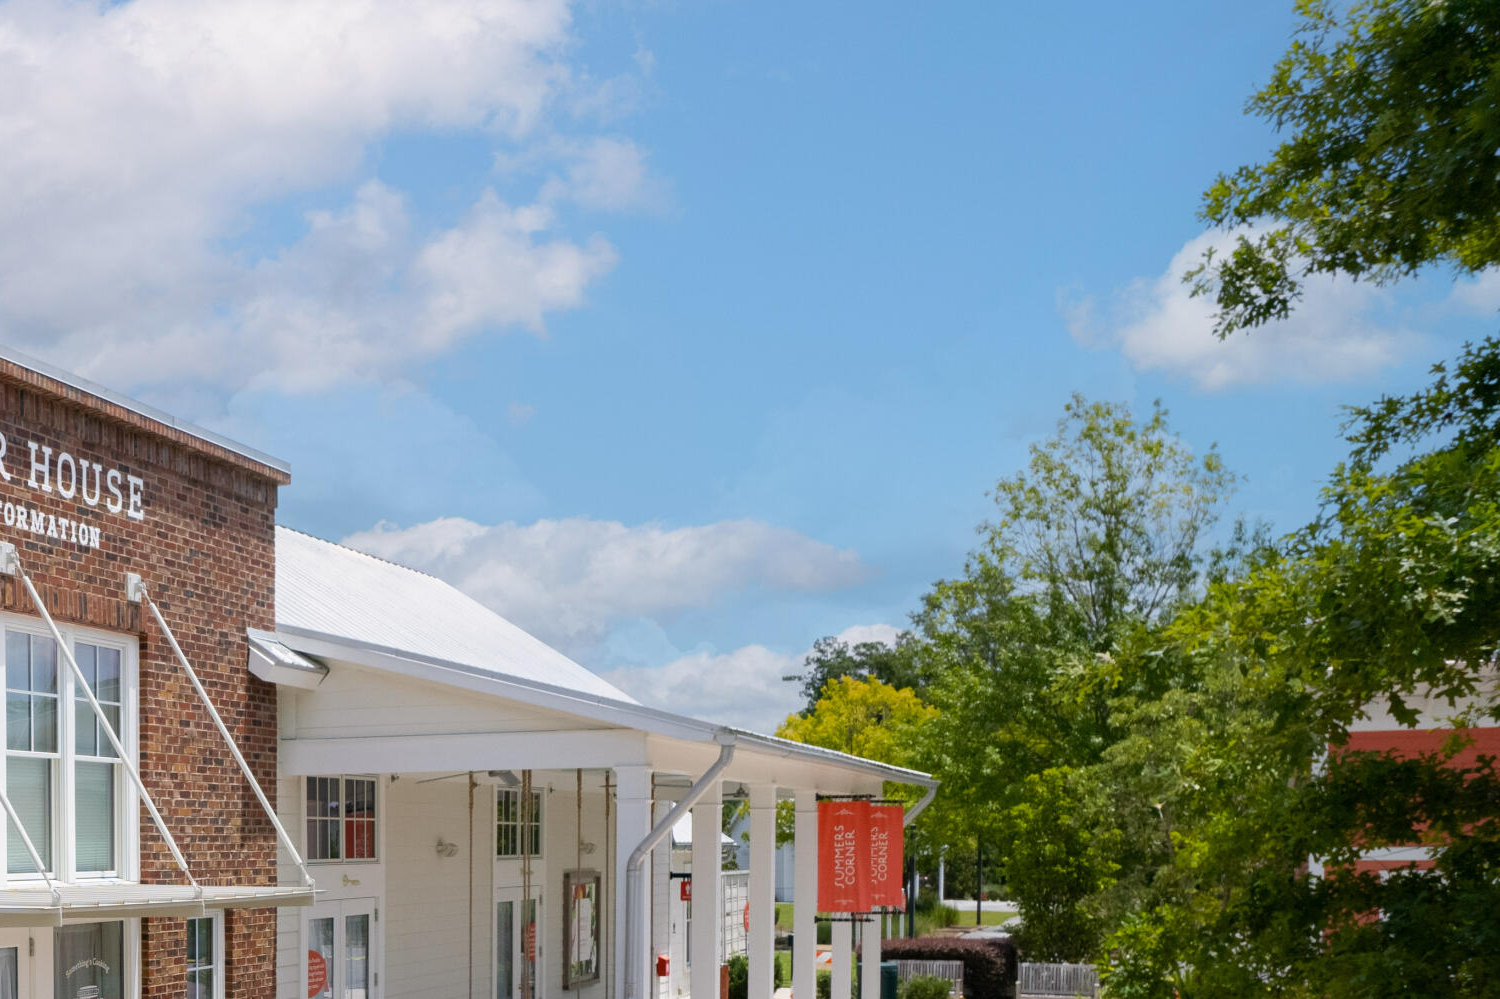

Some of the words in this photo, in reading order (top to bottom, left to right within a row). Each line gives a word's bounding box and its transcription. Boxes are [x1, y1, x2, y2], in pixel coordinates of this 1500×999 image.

[27, 440, 145, 521] HOUSE
[834, 825, 845, 888] SUMMERS
[845, 829, 856, 885] CORNER
[878, 832, 888, 881] CORNER
